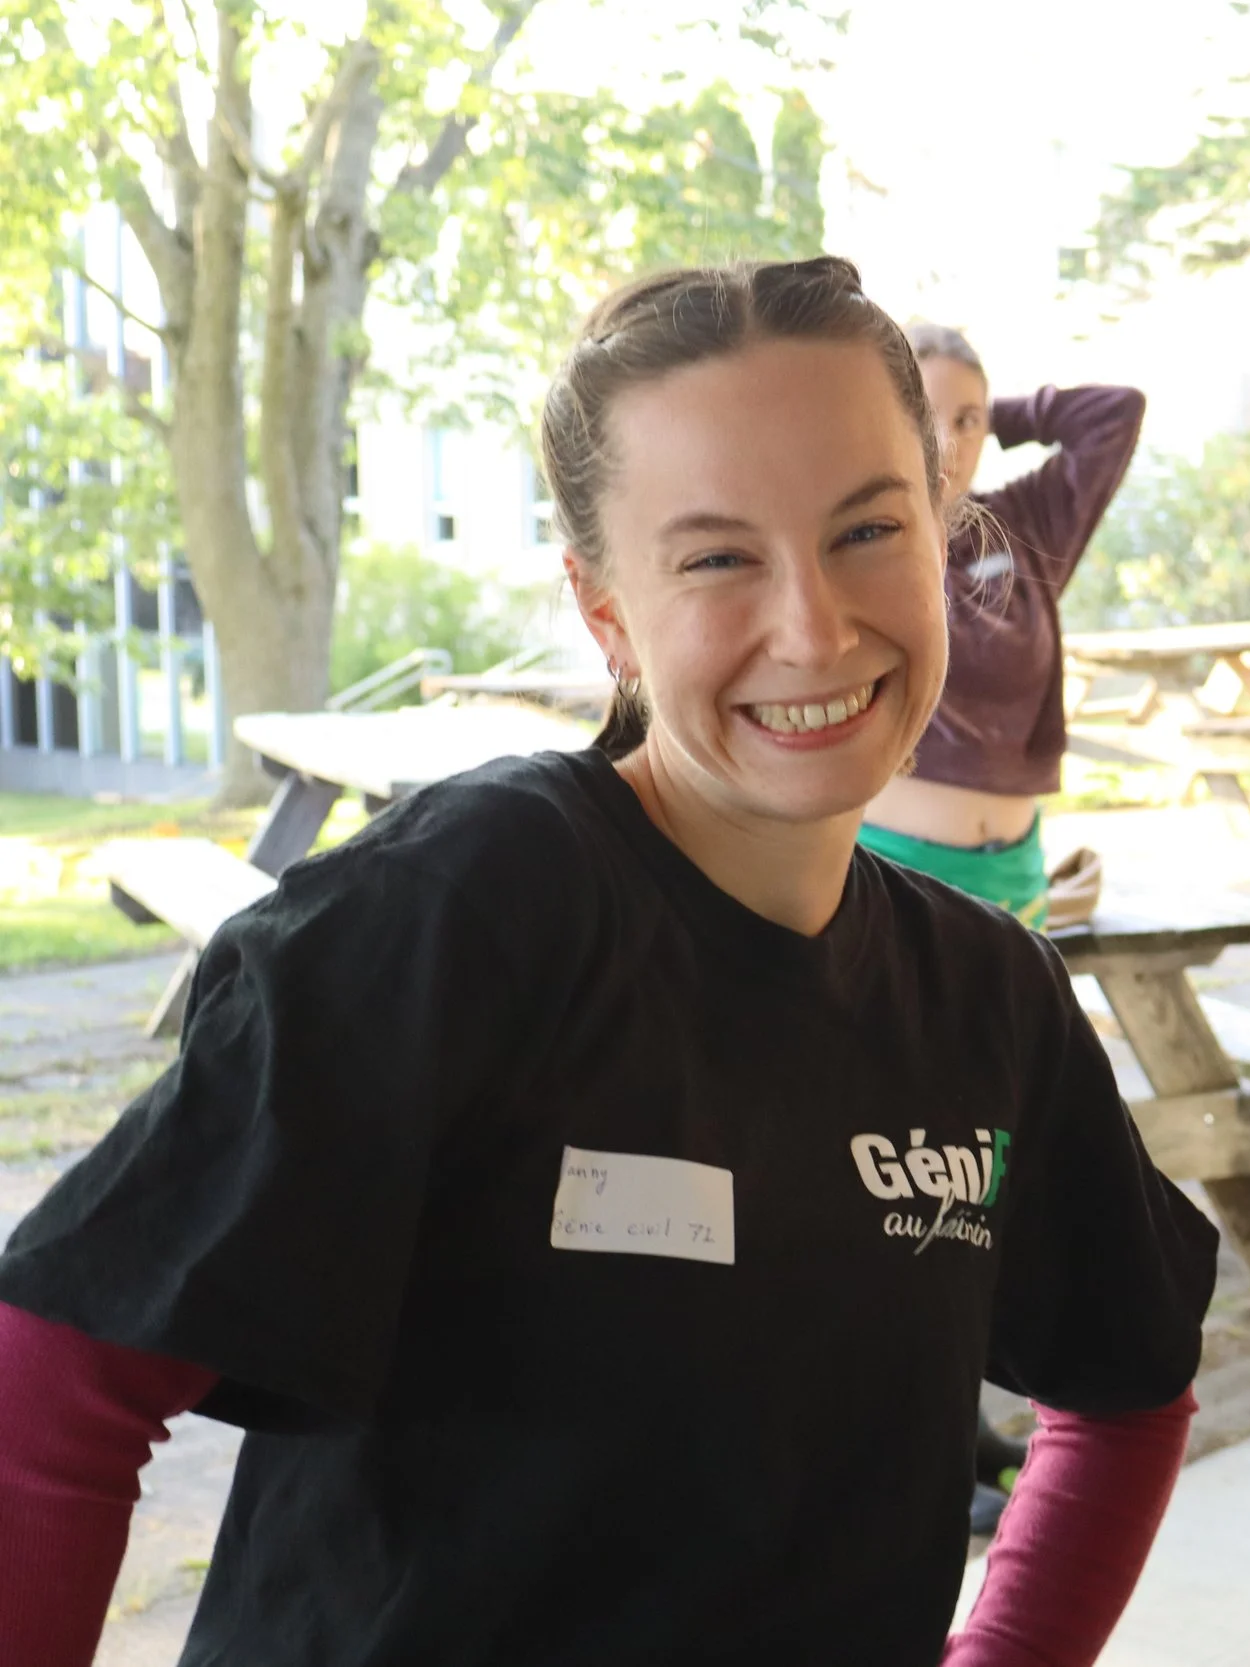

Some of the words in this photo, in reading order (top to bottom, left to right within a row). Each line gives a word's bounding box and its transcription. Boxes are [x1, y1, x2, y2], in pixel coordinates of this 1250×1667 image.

[566, 1166, 608, 1196] anny
[883, 1212, 927, 1239] au
[913, 1183, 994, 1256] finin
